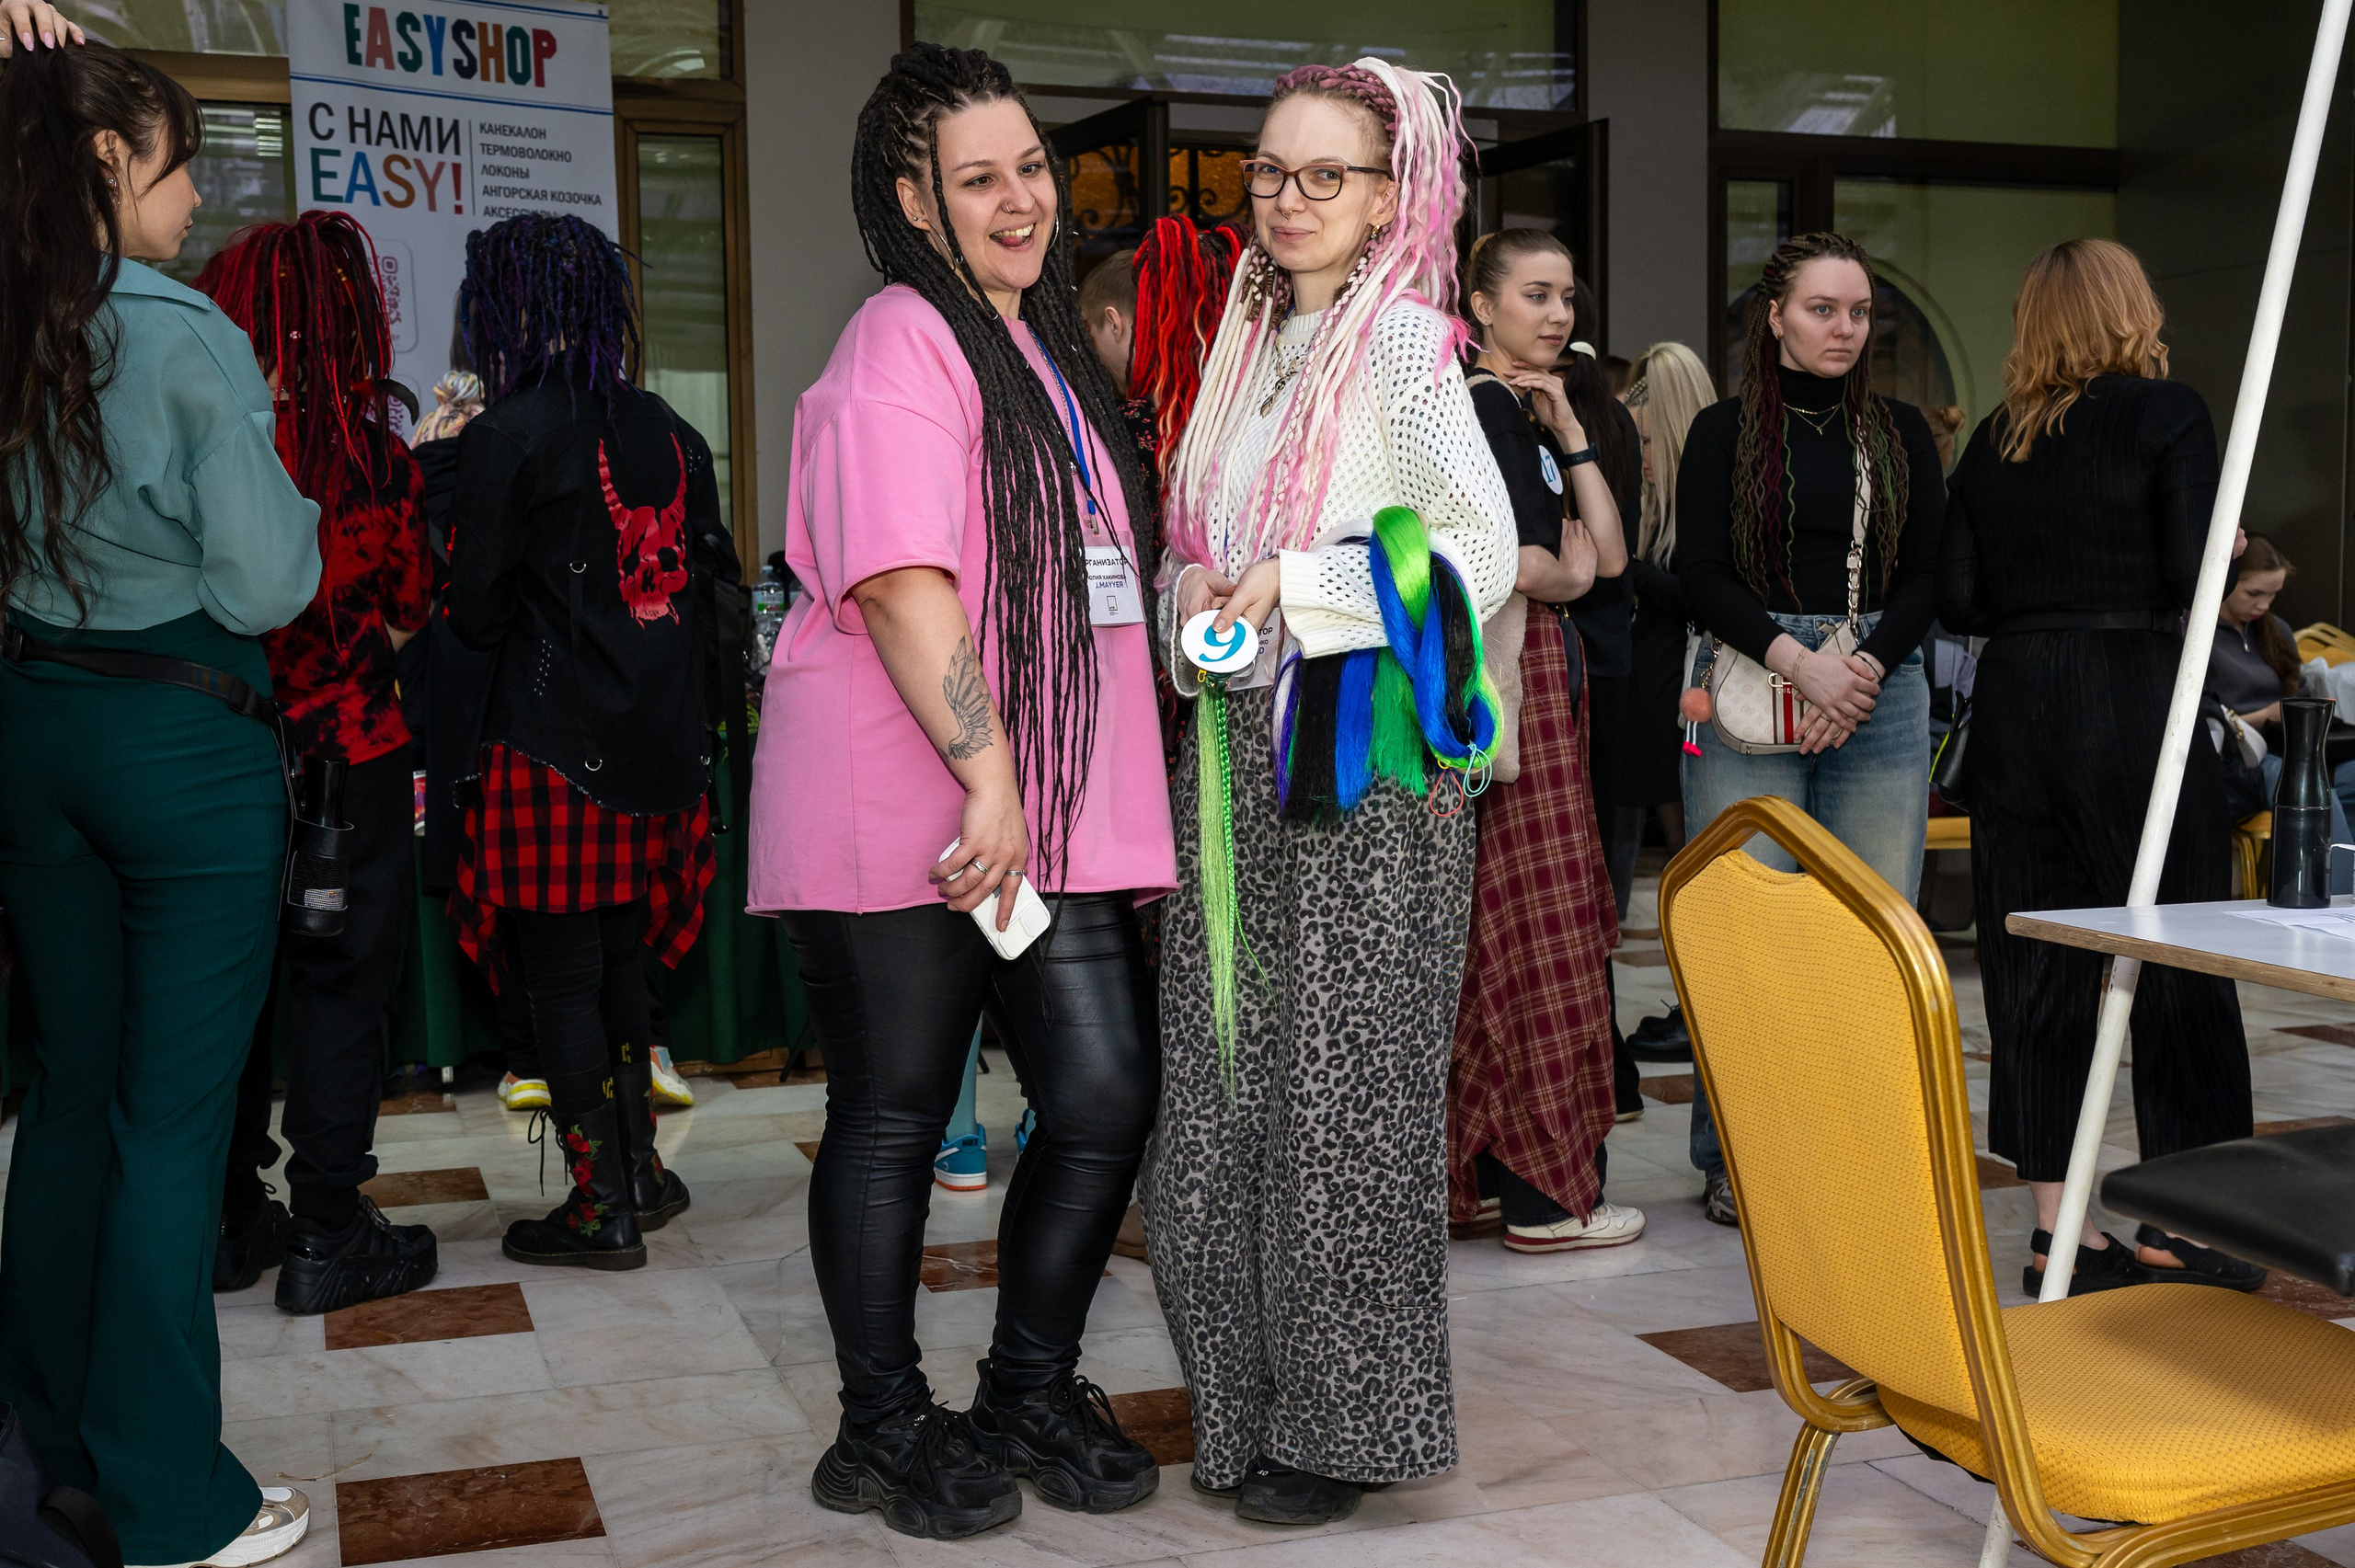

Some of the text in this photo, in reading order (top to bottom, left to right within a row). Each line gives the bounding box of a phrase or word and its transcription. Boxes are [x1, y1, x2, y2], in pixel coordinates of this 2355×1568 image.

[343, 3, 557, 87] EASYSHOP
[309, 102, 460, 155] С НАМИ
[479, 122, 547, 140] КАНЕКАЛОН
[479, 143, 572, 163] ТЕРМОВОЛОКНО
[310, 147, 464, 215] EASY!
[481, 164, 530, 179] ЛОКОНЫ
[482, 185, 603, 206] АНГОРСКАЯ КОЗОЧКА
[1540, 454, 1557, 483] 17
[1086, 557, 1129, 567] РГАНИЗАТОР
[1199, 621, 1246, 662] 9
